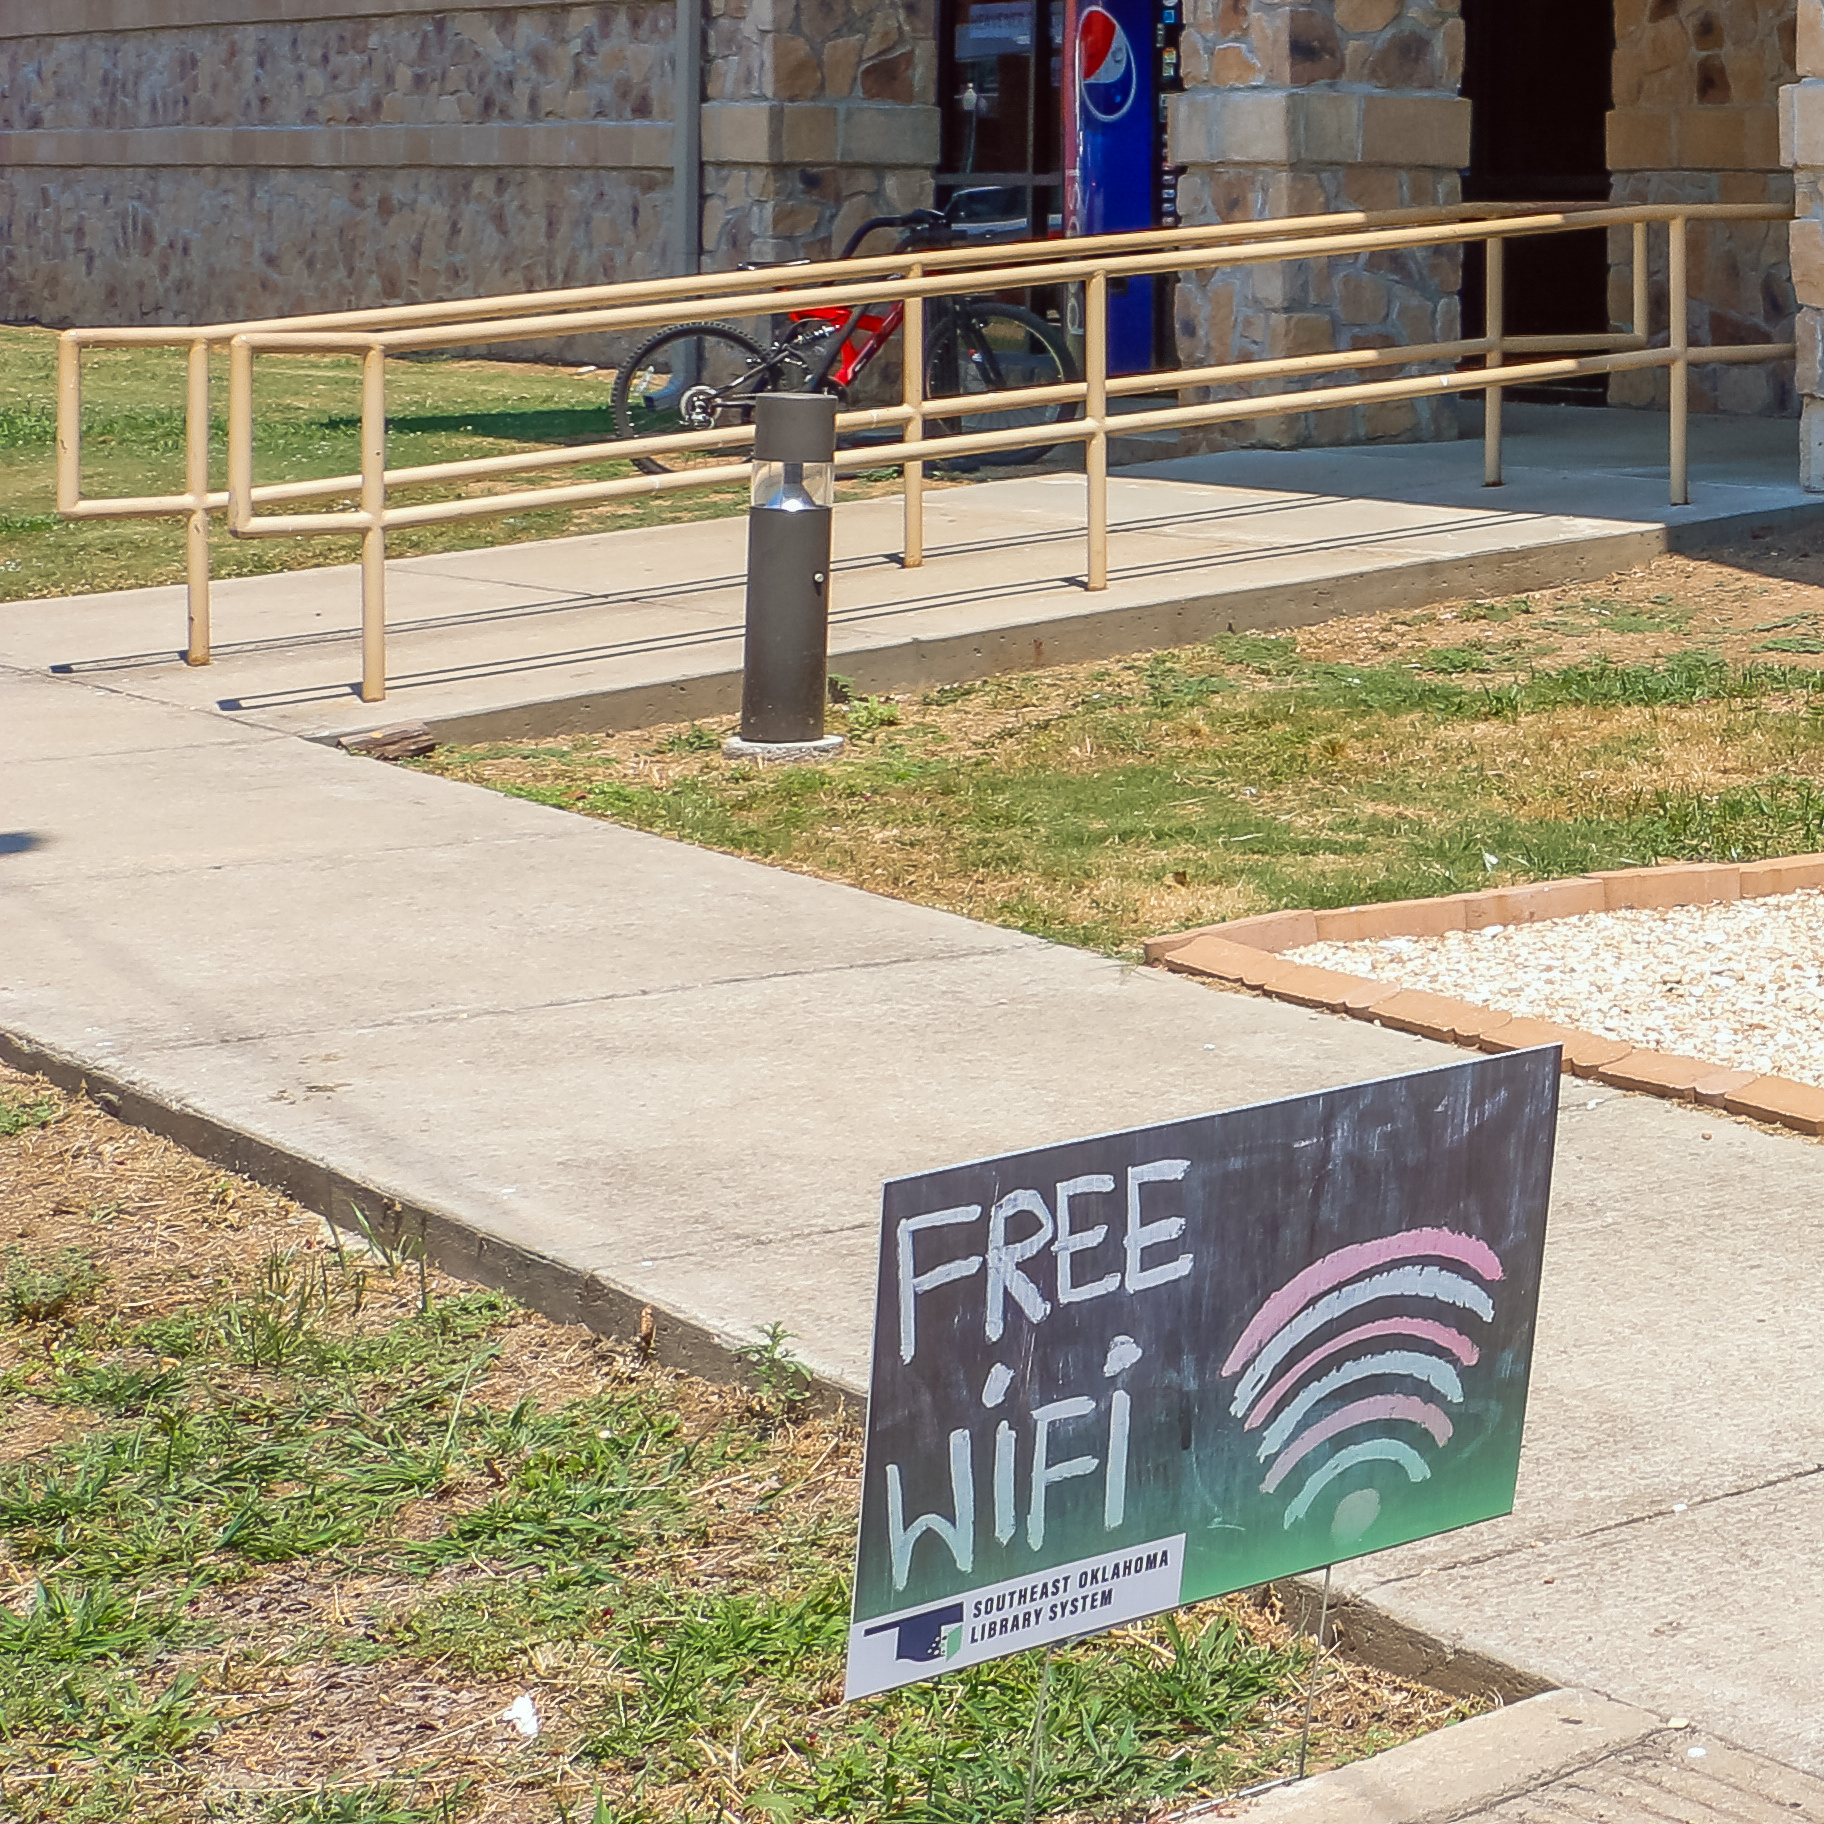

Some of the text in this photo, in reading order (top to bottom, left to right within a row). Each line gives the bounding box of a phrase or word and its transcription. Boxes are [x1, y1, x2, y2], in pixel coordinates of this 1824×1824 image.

[898, 1157, 1195, 1365] FREE
[969, 1586, 1115, 1645] LIBRARY SYSTEM
[971, 1549, 1170, 1620] SOUTHEAST OKLAHOMA
